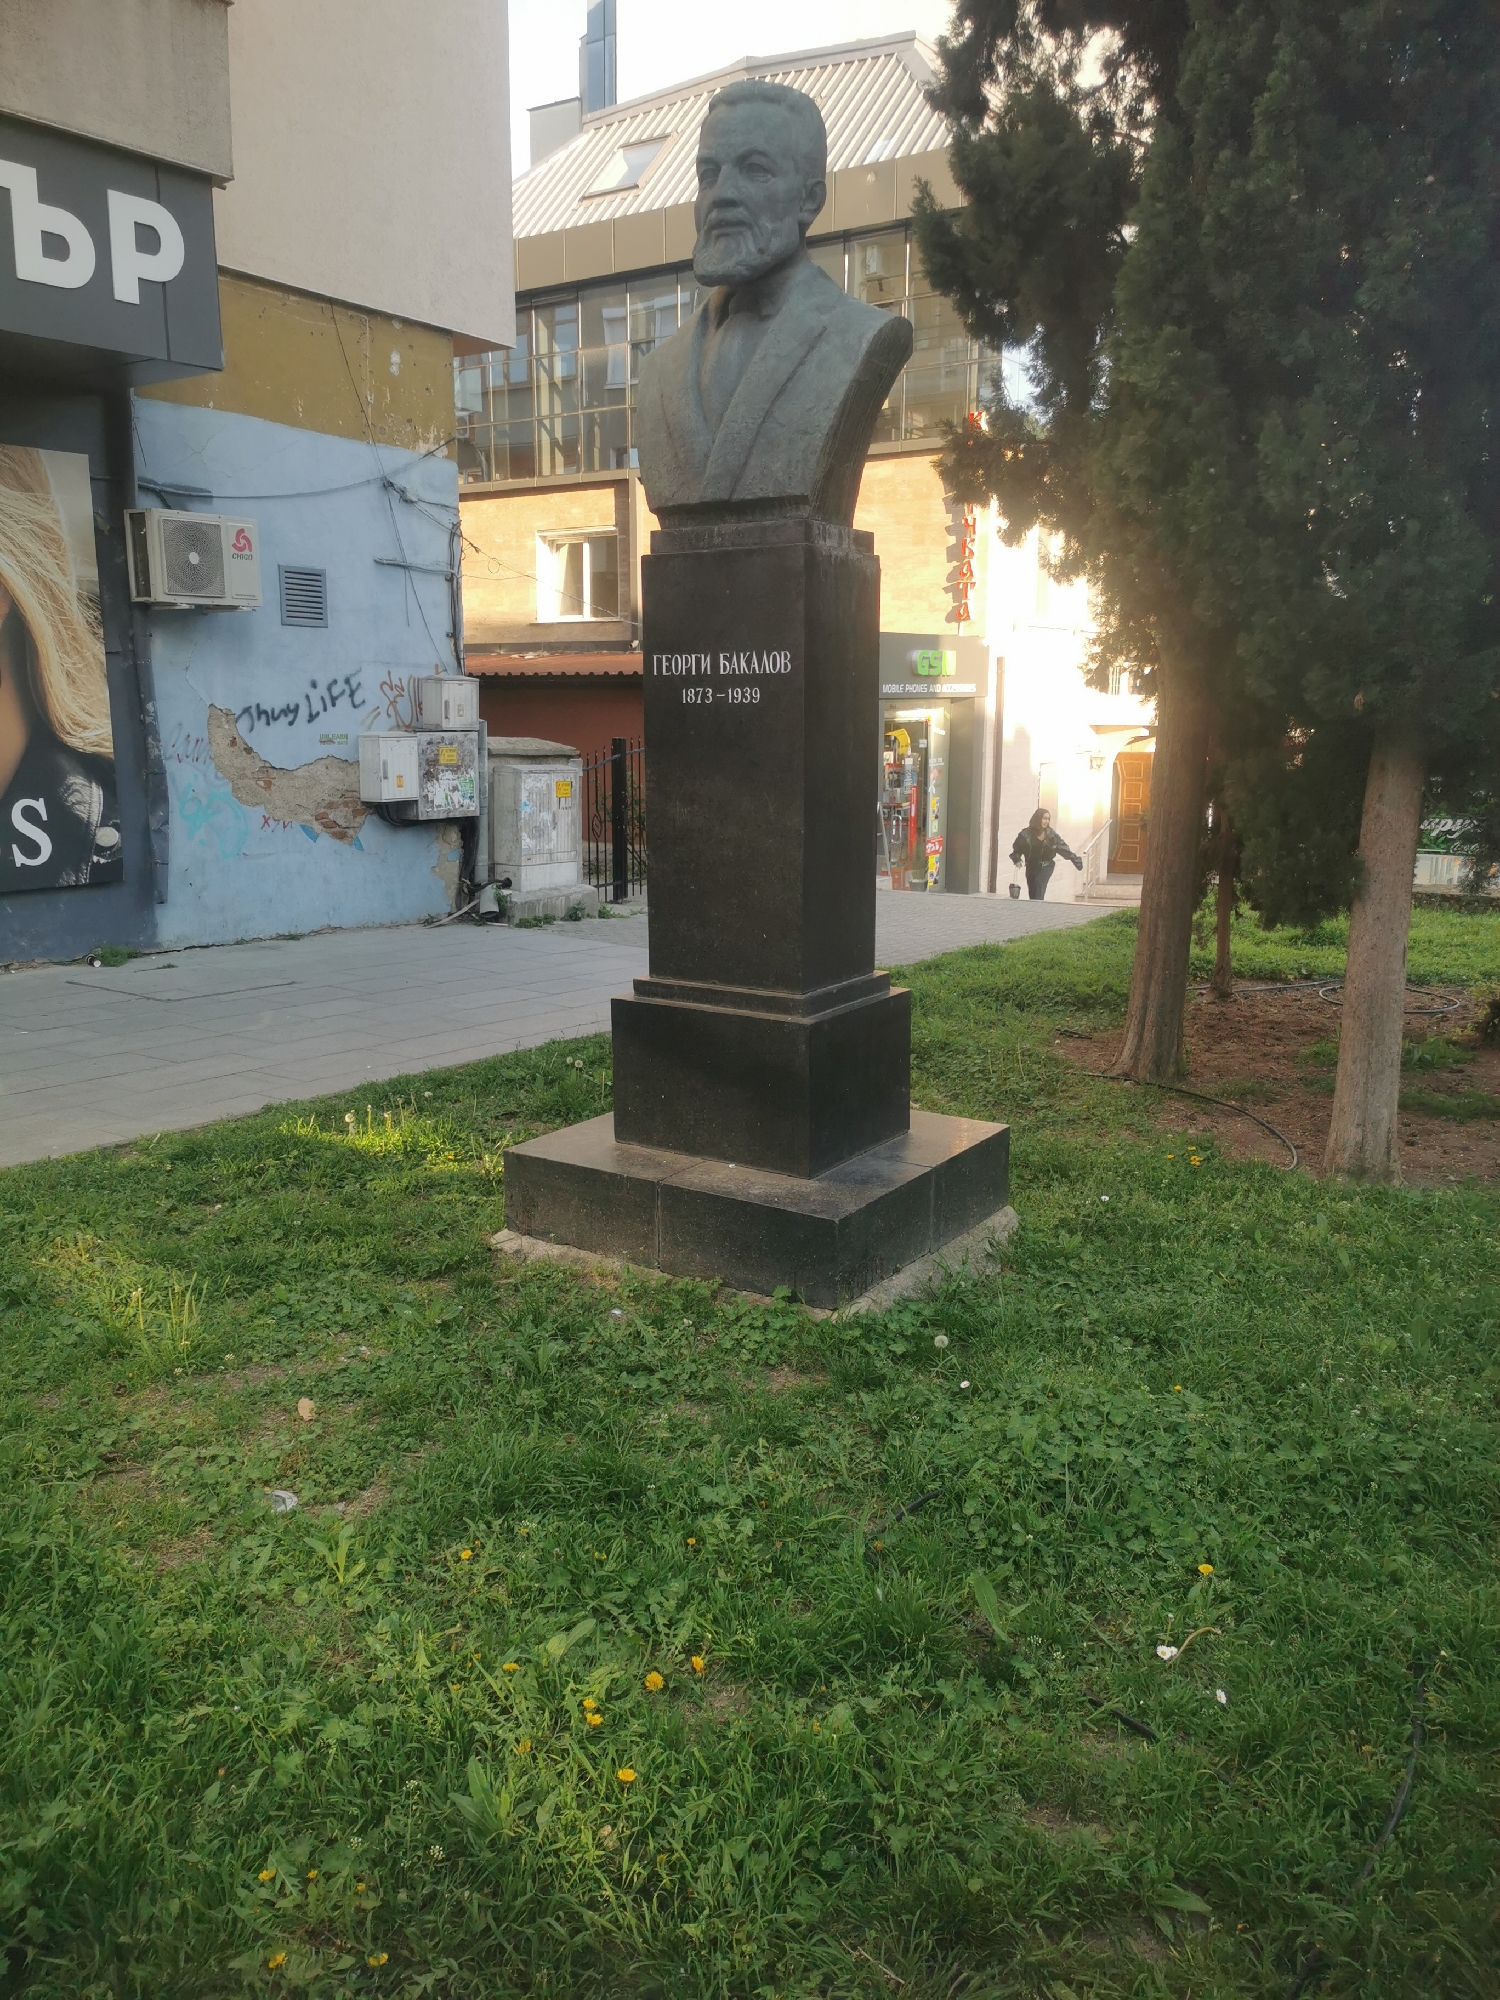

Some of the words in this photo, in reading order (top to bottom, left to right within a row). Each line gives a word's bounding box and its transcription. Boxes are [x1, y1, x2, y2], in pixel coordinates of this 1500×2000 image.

[231, 552, 253, 561] CHIGO
[652, 652, 712, 676] ГЕОРГИ
[719, 649, 792, 675] БАКАЛОВ
[882, 683, 904, 693] MOBILE
[905, 683, 928, 693] PHONES
[929, 683, 942, 693] AND
